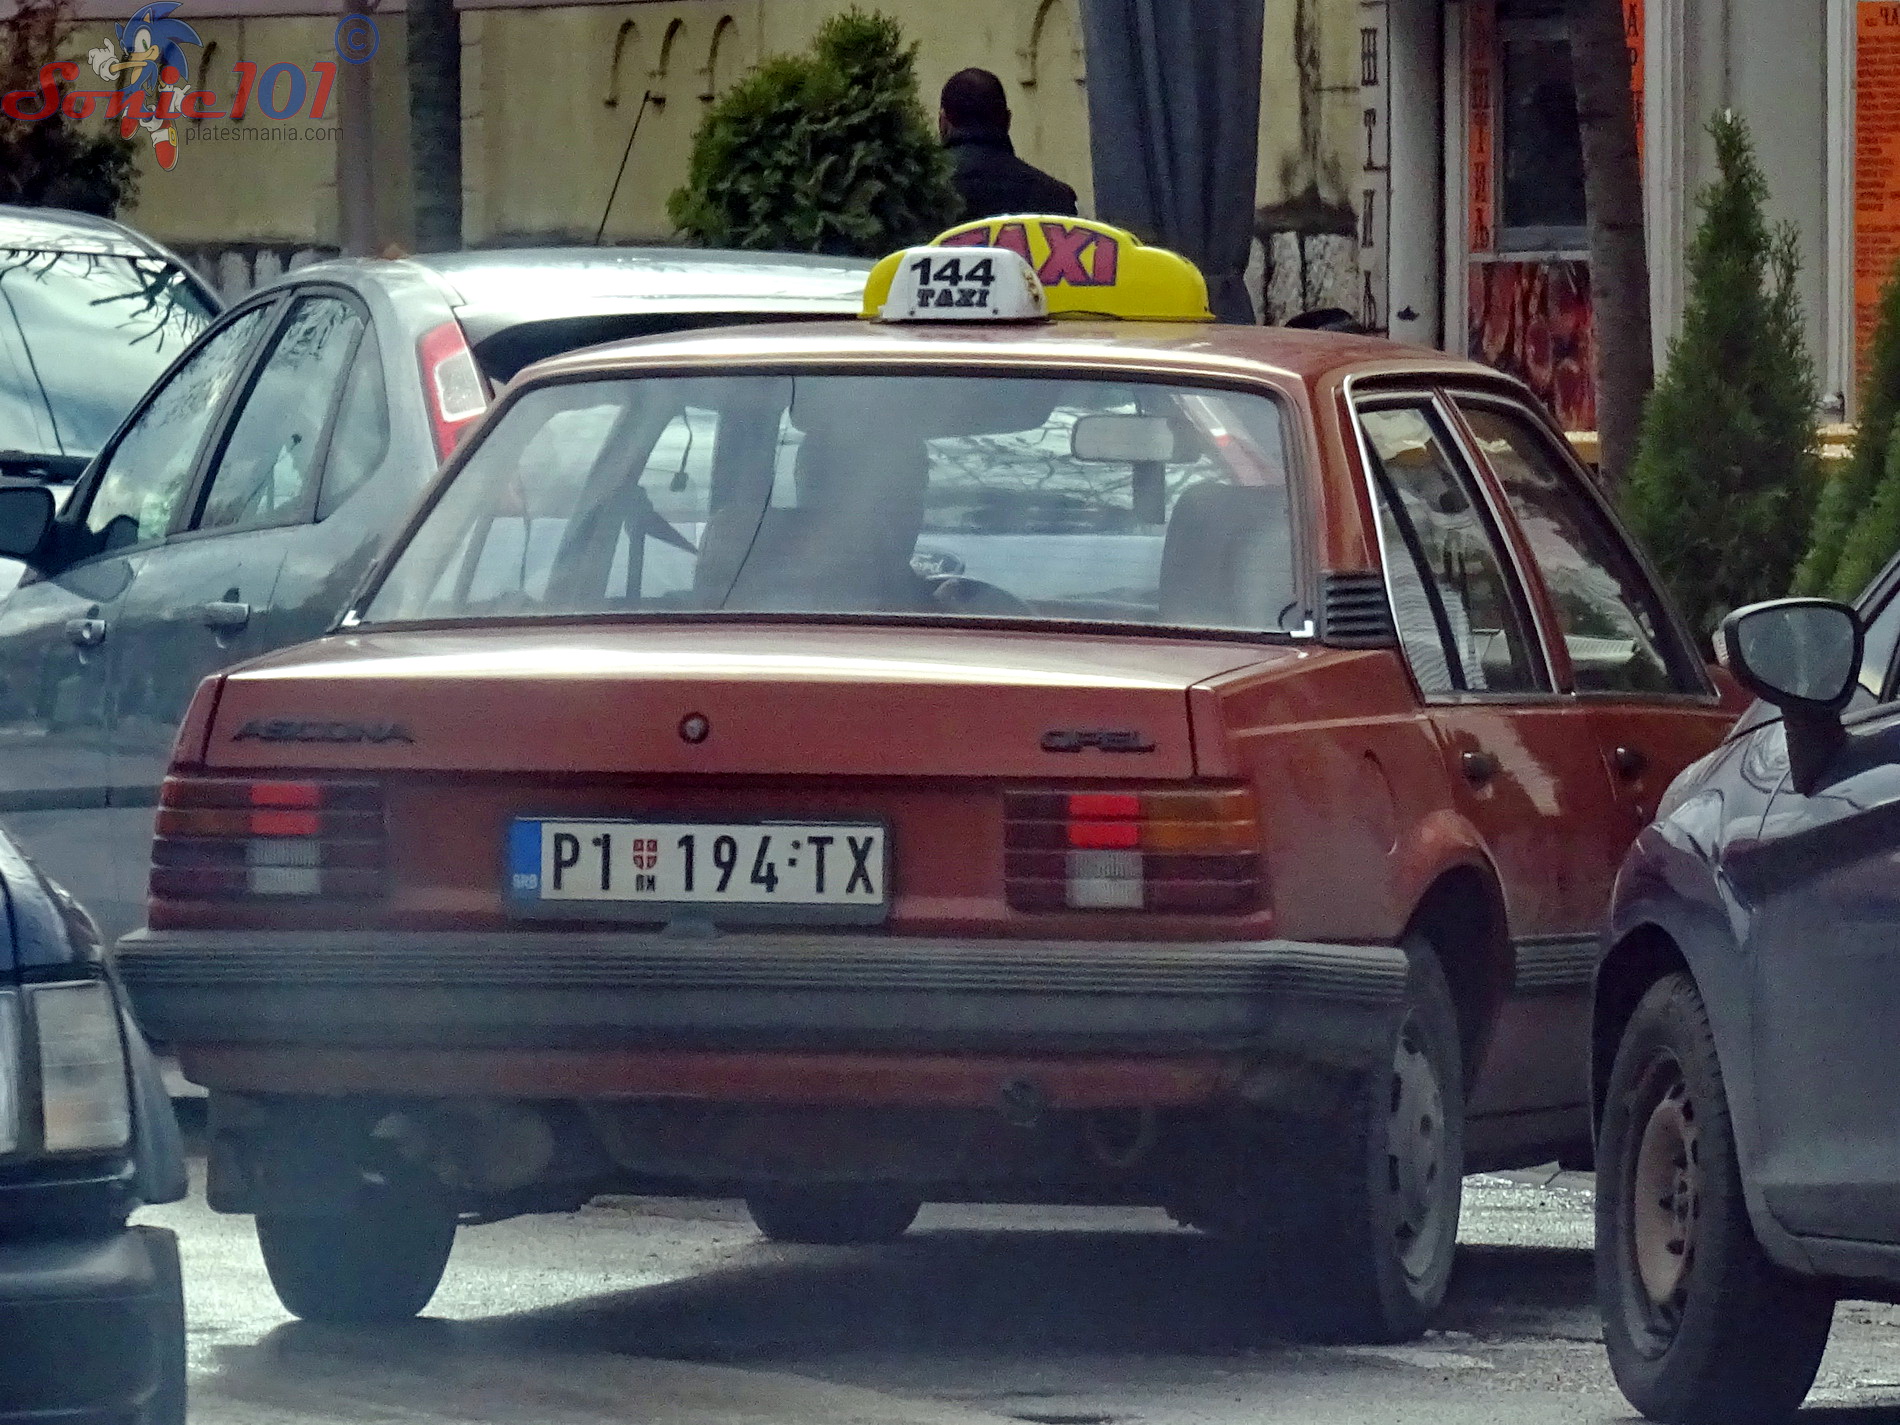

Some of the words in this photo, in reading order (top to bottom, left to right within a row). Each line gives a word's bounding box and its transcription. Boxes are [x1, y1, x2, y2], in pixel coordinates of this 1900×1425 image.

[910, 257, 996, 287] 144
[917, 288, 990, 308] TAXI
[1040, 730, 1156, 754] OPEL
